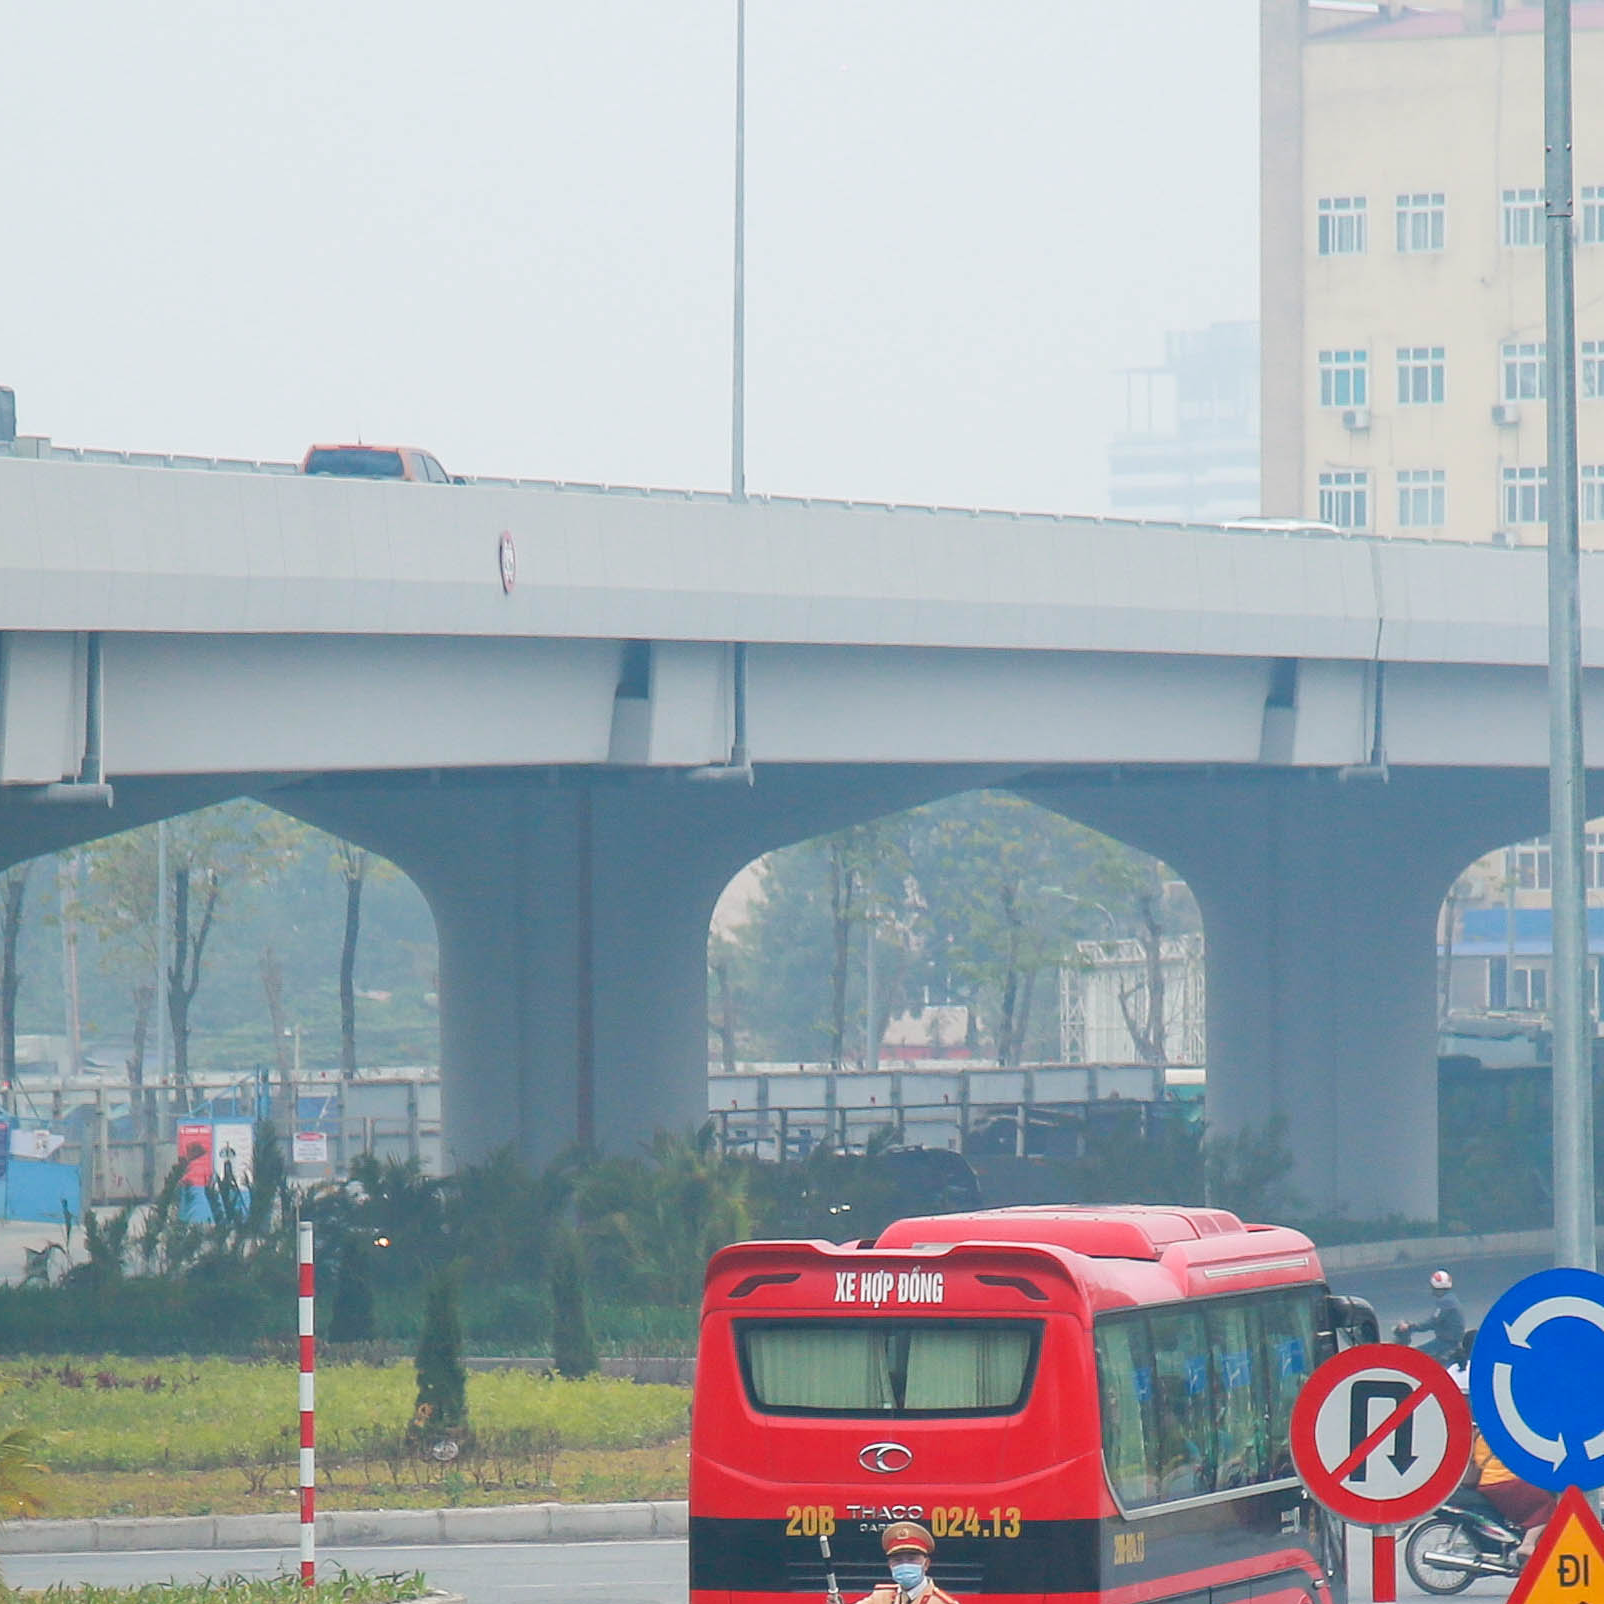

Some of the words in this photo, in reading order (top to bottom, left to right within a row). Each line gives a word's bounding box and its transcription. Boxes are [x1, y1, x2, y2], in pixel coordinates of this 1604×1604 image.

[834, 1272, 856, 1302] XE
[860, 1270, 894, 1308] HỢP
[786, 1505, 836, 1537] 20B
[931, 1506, 1021, 1538] 024.13
[846, 1505, 924, 1520] THACO
[1557, 1554, 1590, 1588] ĐI
